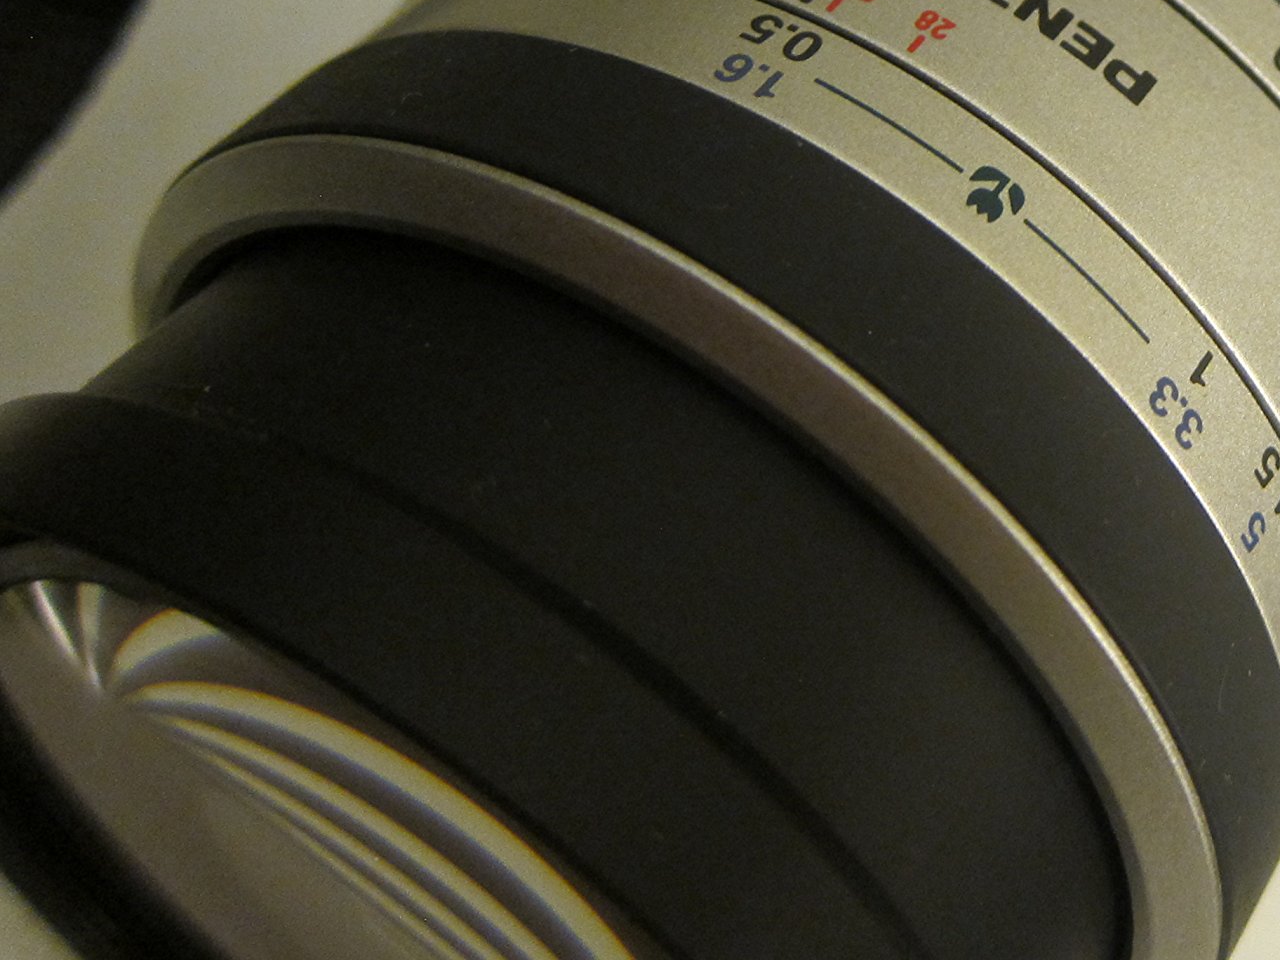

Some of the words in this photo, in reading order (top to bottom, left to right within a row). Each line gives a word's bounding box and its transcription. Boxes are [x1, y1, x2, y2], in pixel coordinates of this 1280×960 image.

[739, 14, 823, 62] 0.5
[914, 9, 957, 40] 28
[713, 53, 785, 99] 1.6
[1189, 350, 1214, 387] 1
[1148, 376, 1203, 450] 3.3
[1240, 511, 1267, 553] 5
